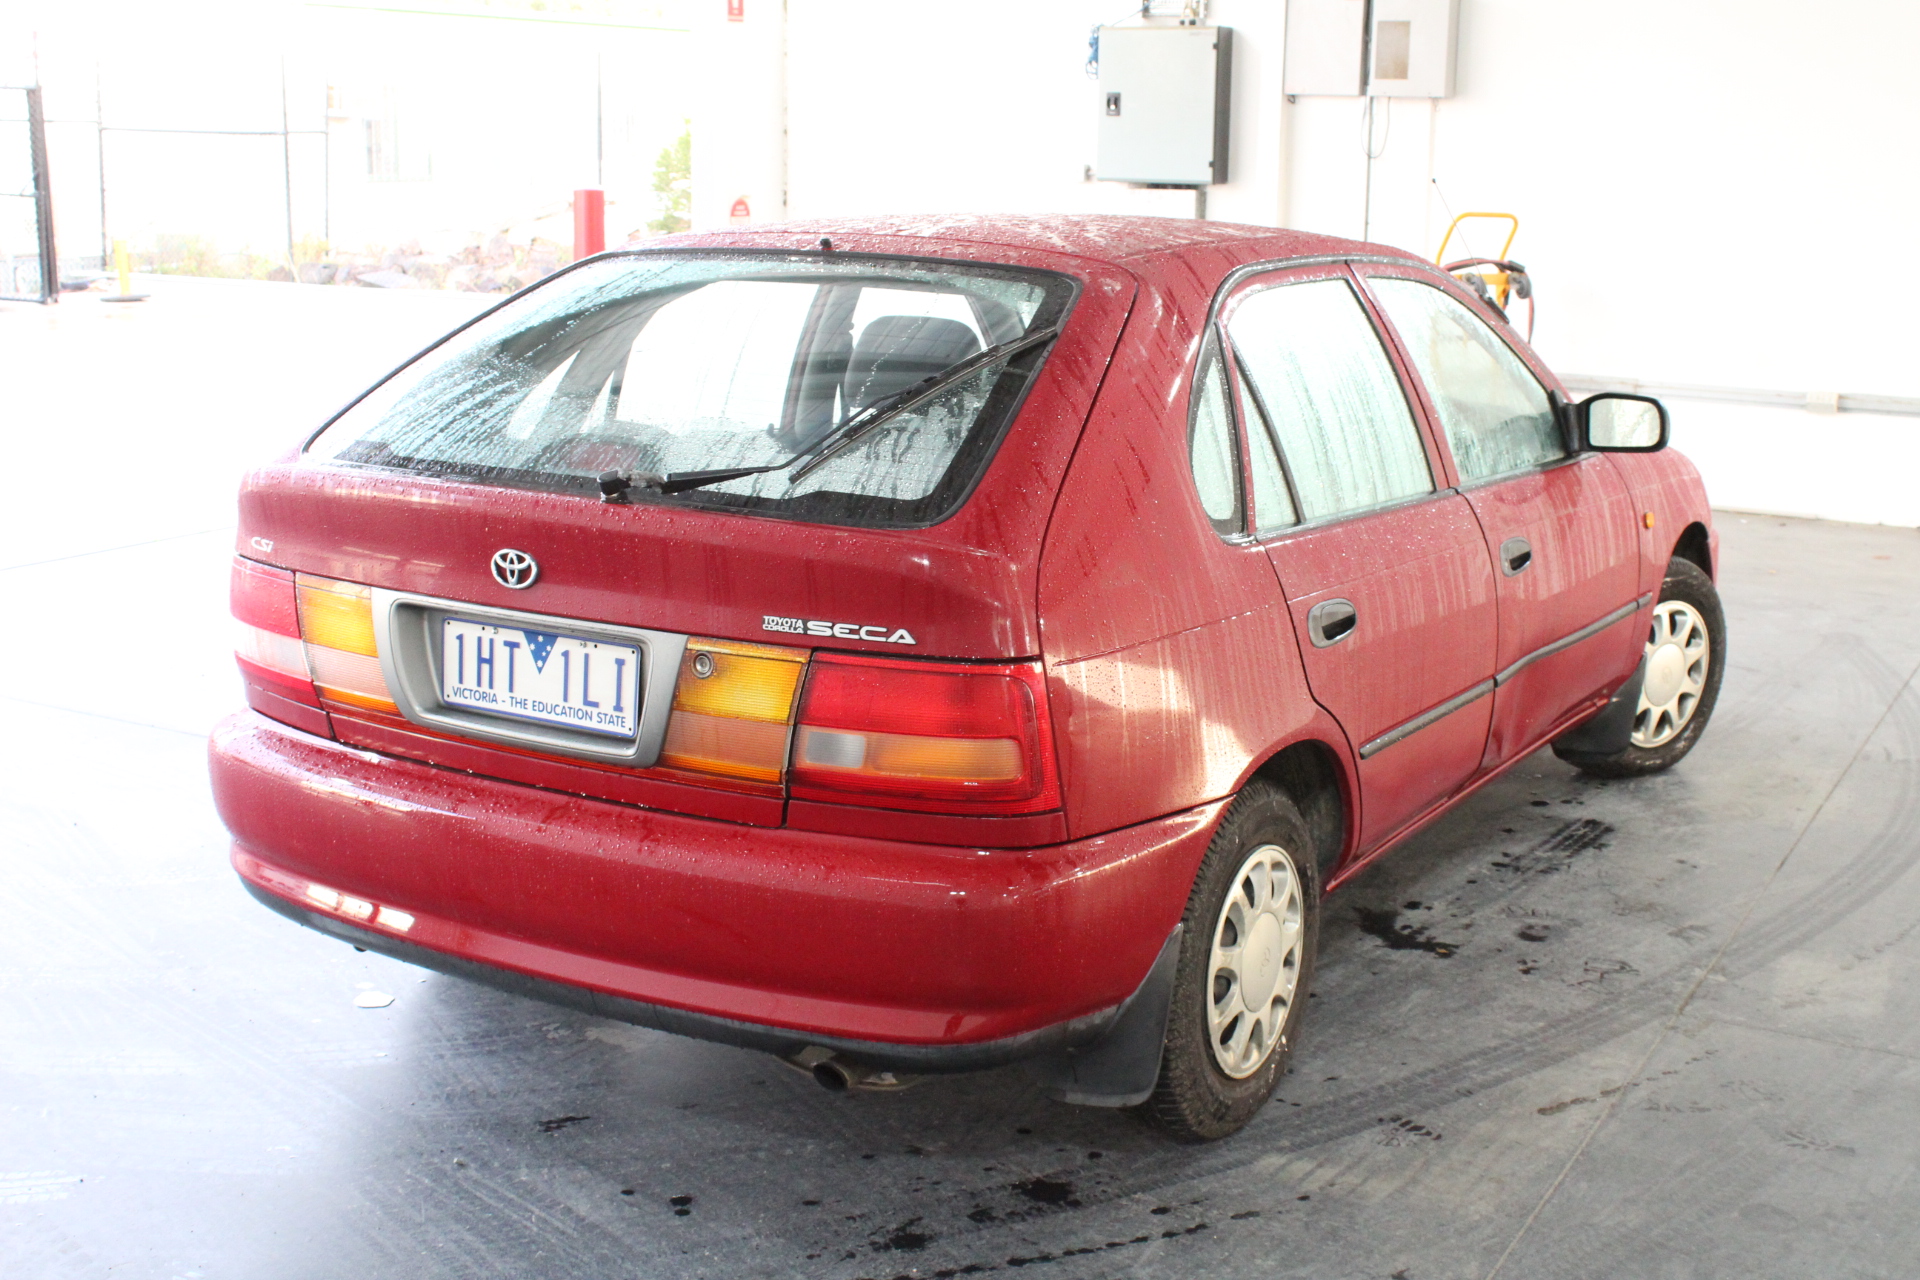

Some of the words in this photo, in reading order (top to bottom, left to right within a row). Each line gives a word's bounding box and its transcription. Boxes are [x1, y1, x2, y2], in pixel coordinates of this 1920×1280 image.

[763, 615, 804, 628] TOYOTA
[763, 624, 804, 634] COROLLA
[807, 620, 917, 645] SECA
[455, 632, 521, 694] 1HT
[560, 649, 626, 713] 1LI
[452, 686, 498, 704] VICTORIA
[509, 695, 529, 710] THE
[532, 701, 593, 722] EDUCATION
[596, 711, 627, 729] STATE
